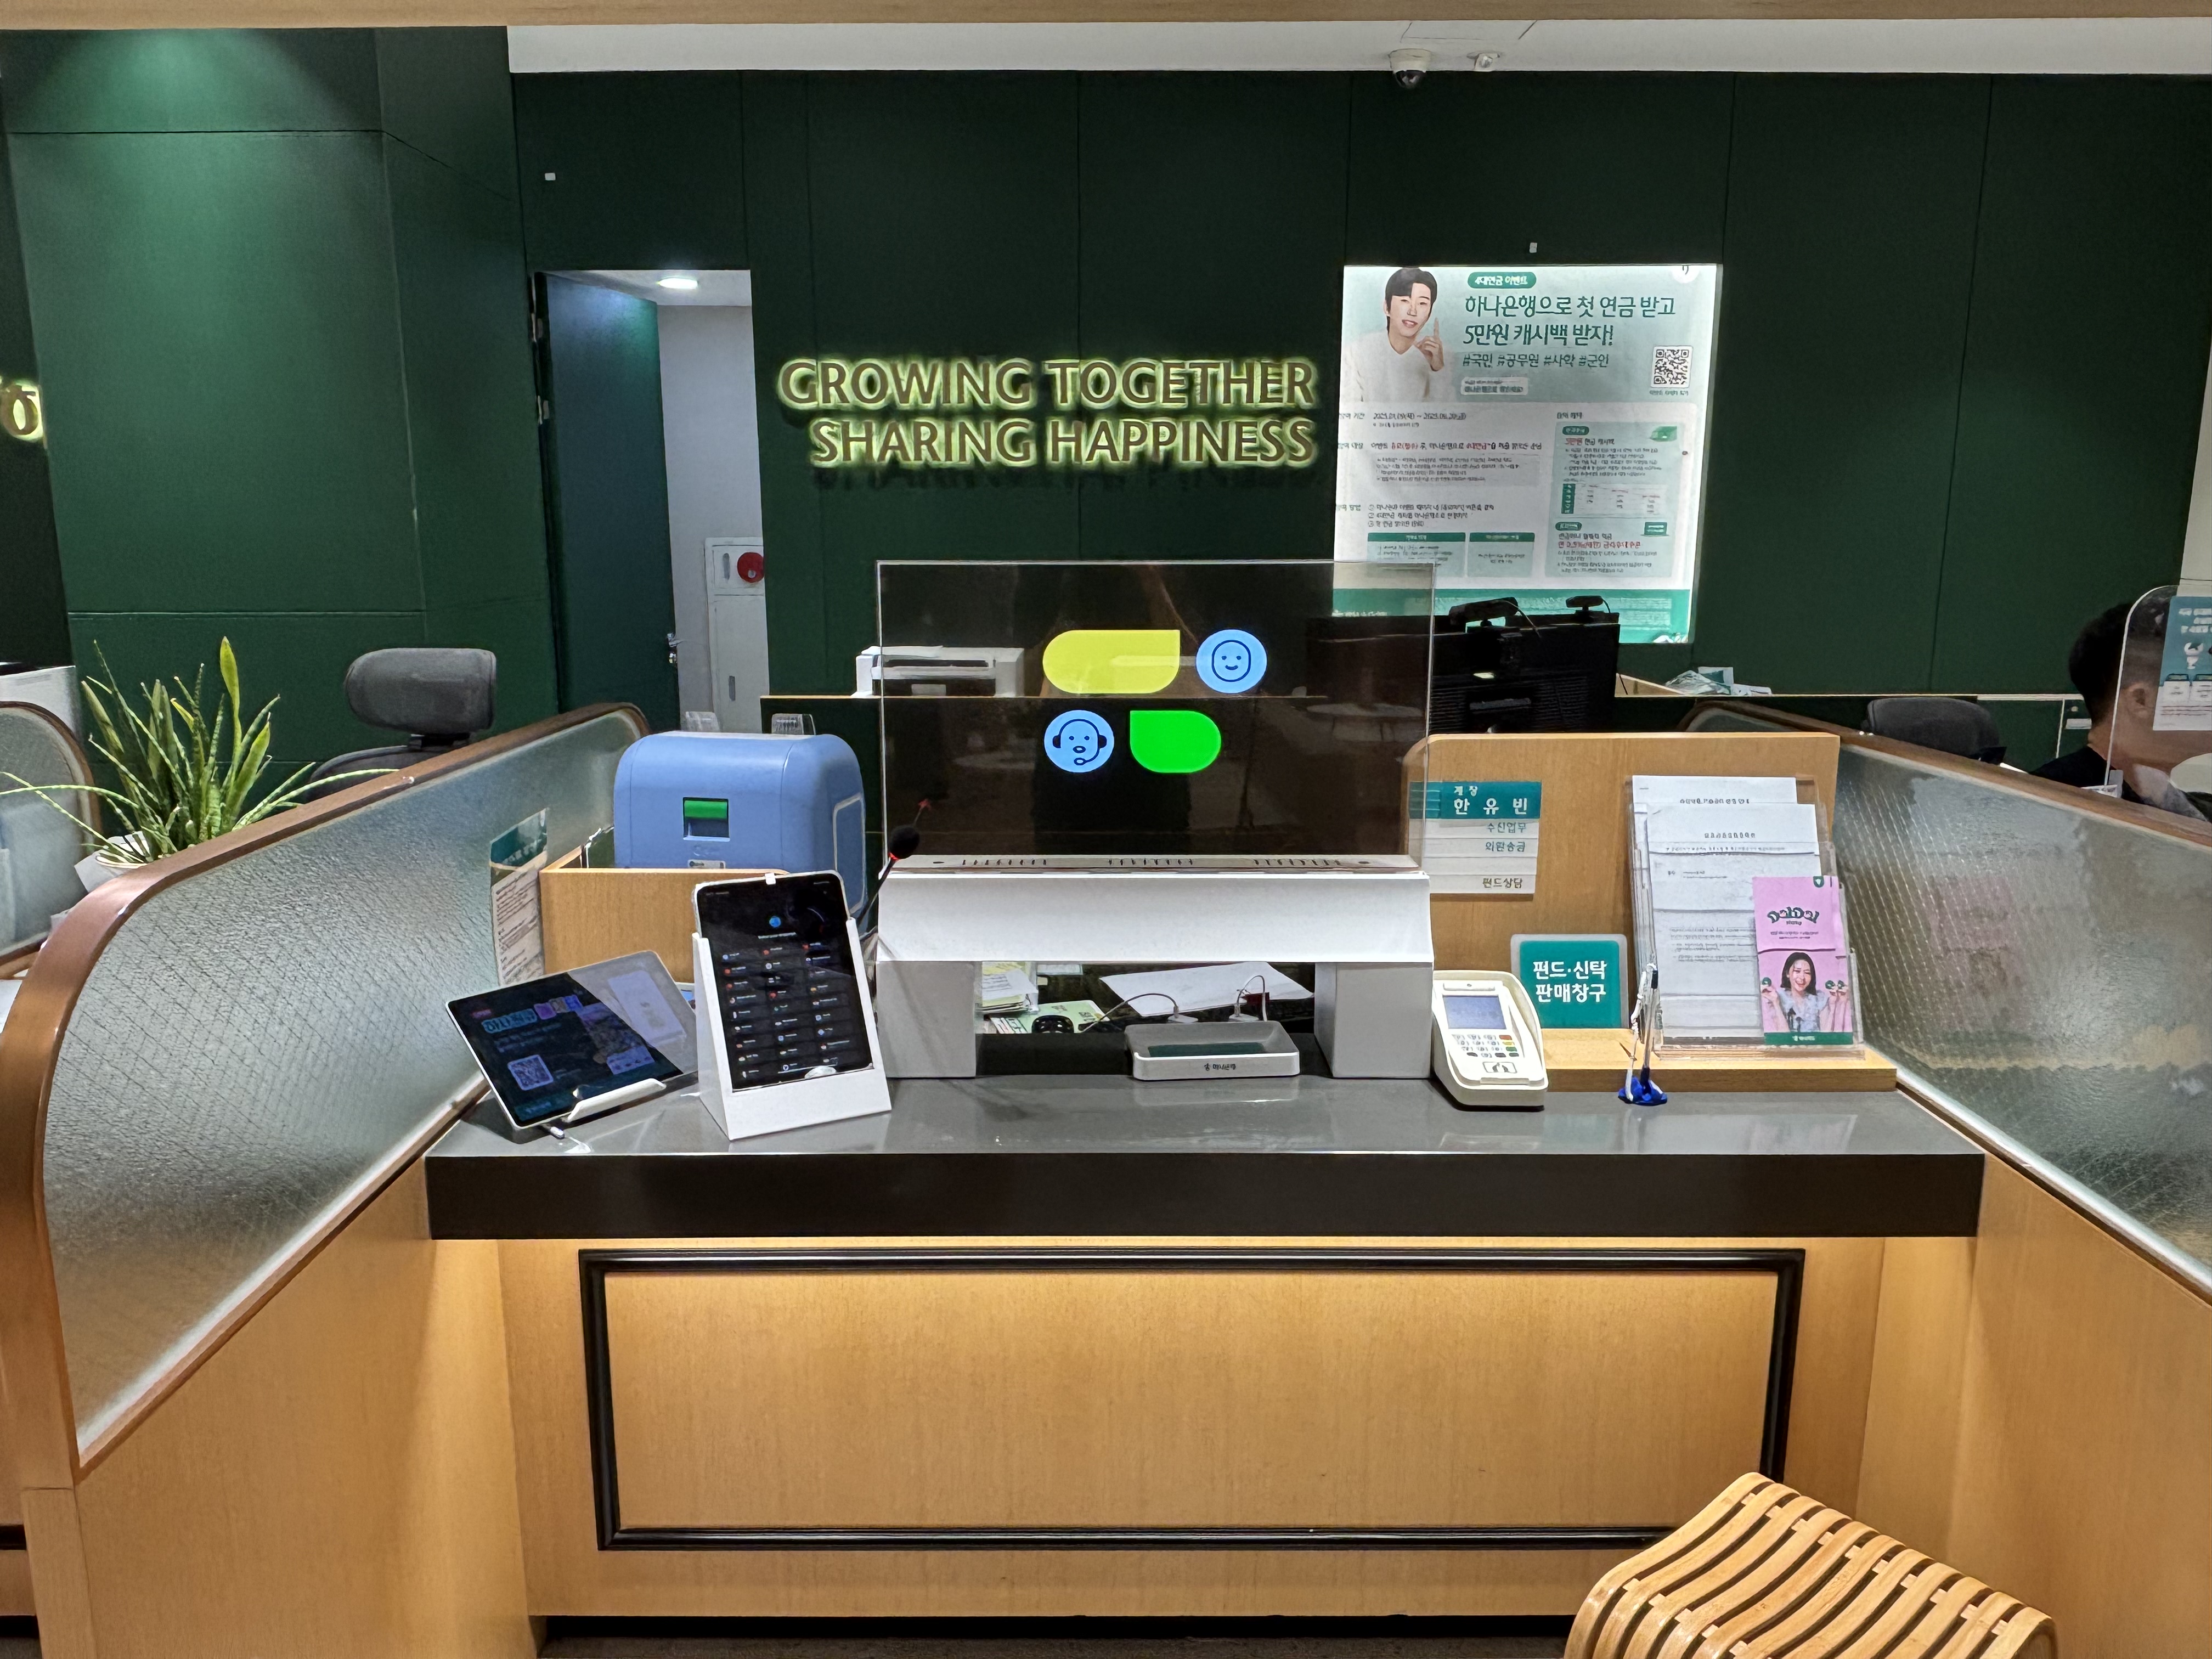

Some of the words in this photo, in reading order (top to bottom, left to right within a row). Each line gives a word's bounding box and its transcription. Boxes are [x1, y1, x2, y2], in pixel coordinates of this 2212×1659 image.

[1465, 295, 1573, 318] 하나은행으로
[1576, 295, 1594, 318] 첫
[1599, 296, 1637, 318] 연금
[1640, 296, 1676, 318] 받고
[1463, 324, 1509, 346] 5만원
[1513, 324, 1568, 346] 캐시백
[1572, 324, 1614, 347] 받자!
[1463, 353, 1493, 368] #국민
[779, 360, 1034, 406] GROWING
[1046, 360, 1316, 406] TOGETHER
[811, 419, 1034, 464] SHARING
[1049, 419, 1316, 464] HAPPINESS
[1487, 822, 1527, 833] 수신업무
[1482, 878, 1523, 889] 펀드상담
[1533, 960, 1608, 980] 펀드·신탁
[1536, 983, 1607, 1003] 판매창구
